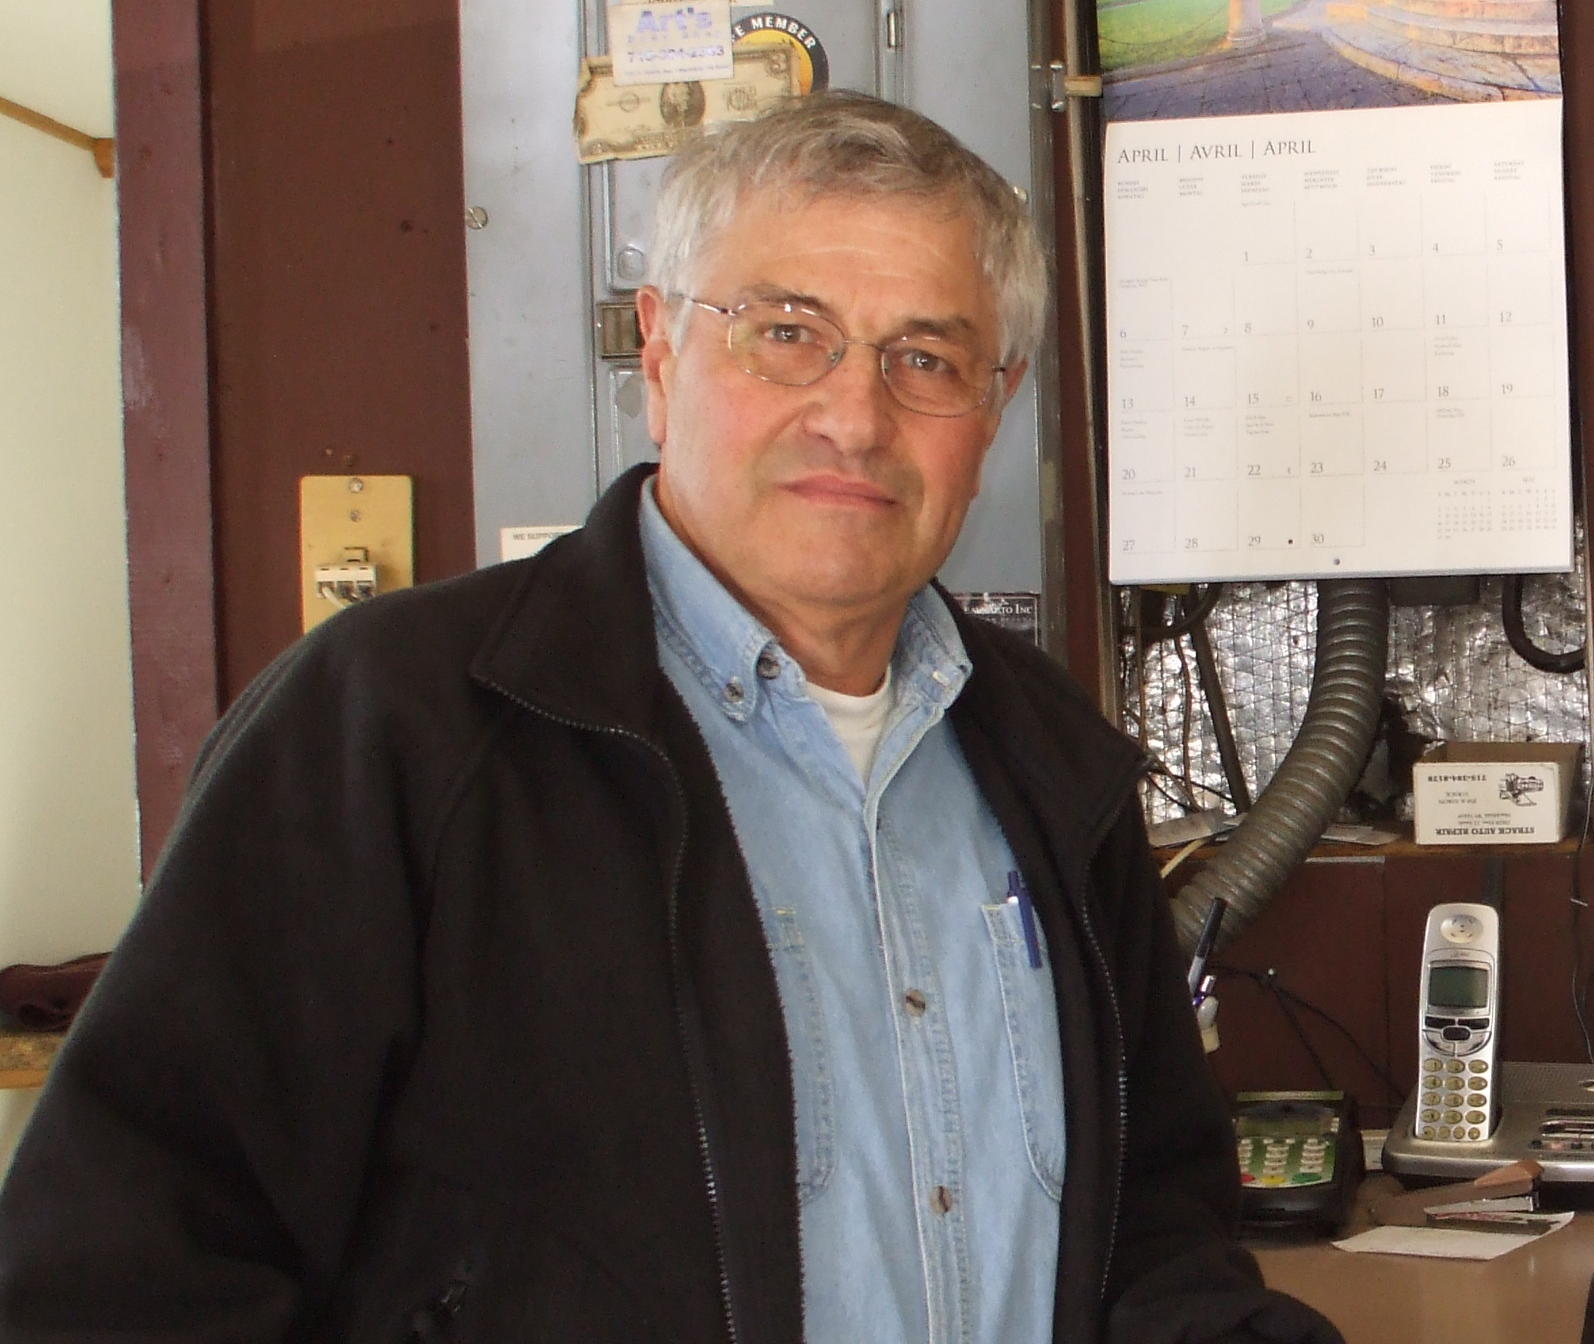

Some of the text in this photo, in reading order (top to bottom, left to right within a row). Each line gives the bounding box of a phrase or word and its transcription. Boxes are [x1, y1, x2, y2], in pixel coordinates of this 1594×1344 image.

[751, 15, 818, 51] MEMBER
[1117, 140, 1317, 164] APRIL AVRIL APRIL
[1243, 239, 1503, 261] 1 2 3 4 5
[1119, 312, 1512, 338] 6 7 8 9 10 11 12
[1122, 384, 1513, 409] 13 14 15 16 17 18 19
[1122, 456, 1516, 480] 20 21 22 23 24 25 26
[513, 533, 526, 541] WE
[1122, 533, 1324, 551] 27 28 29 30
[1435, 826, 1535, 836] STRACK AUTO REPAIR
